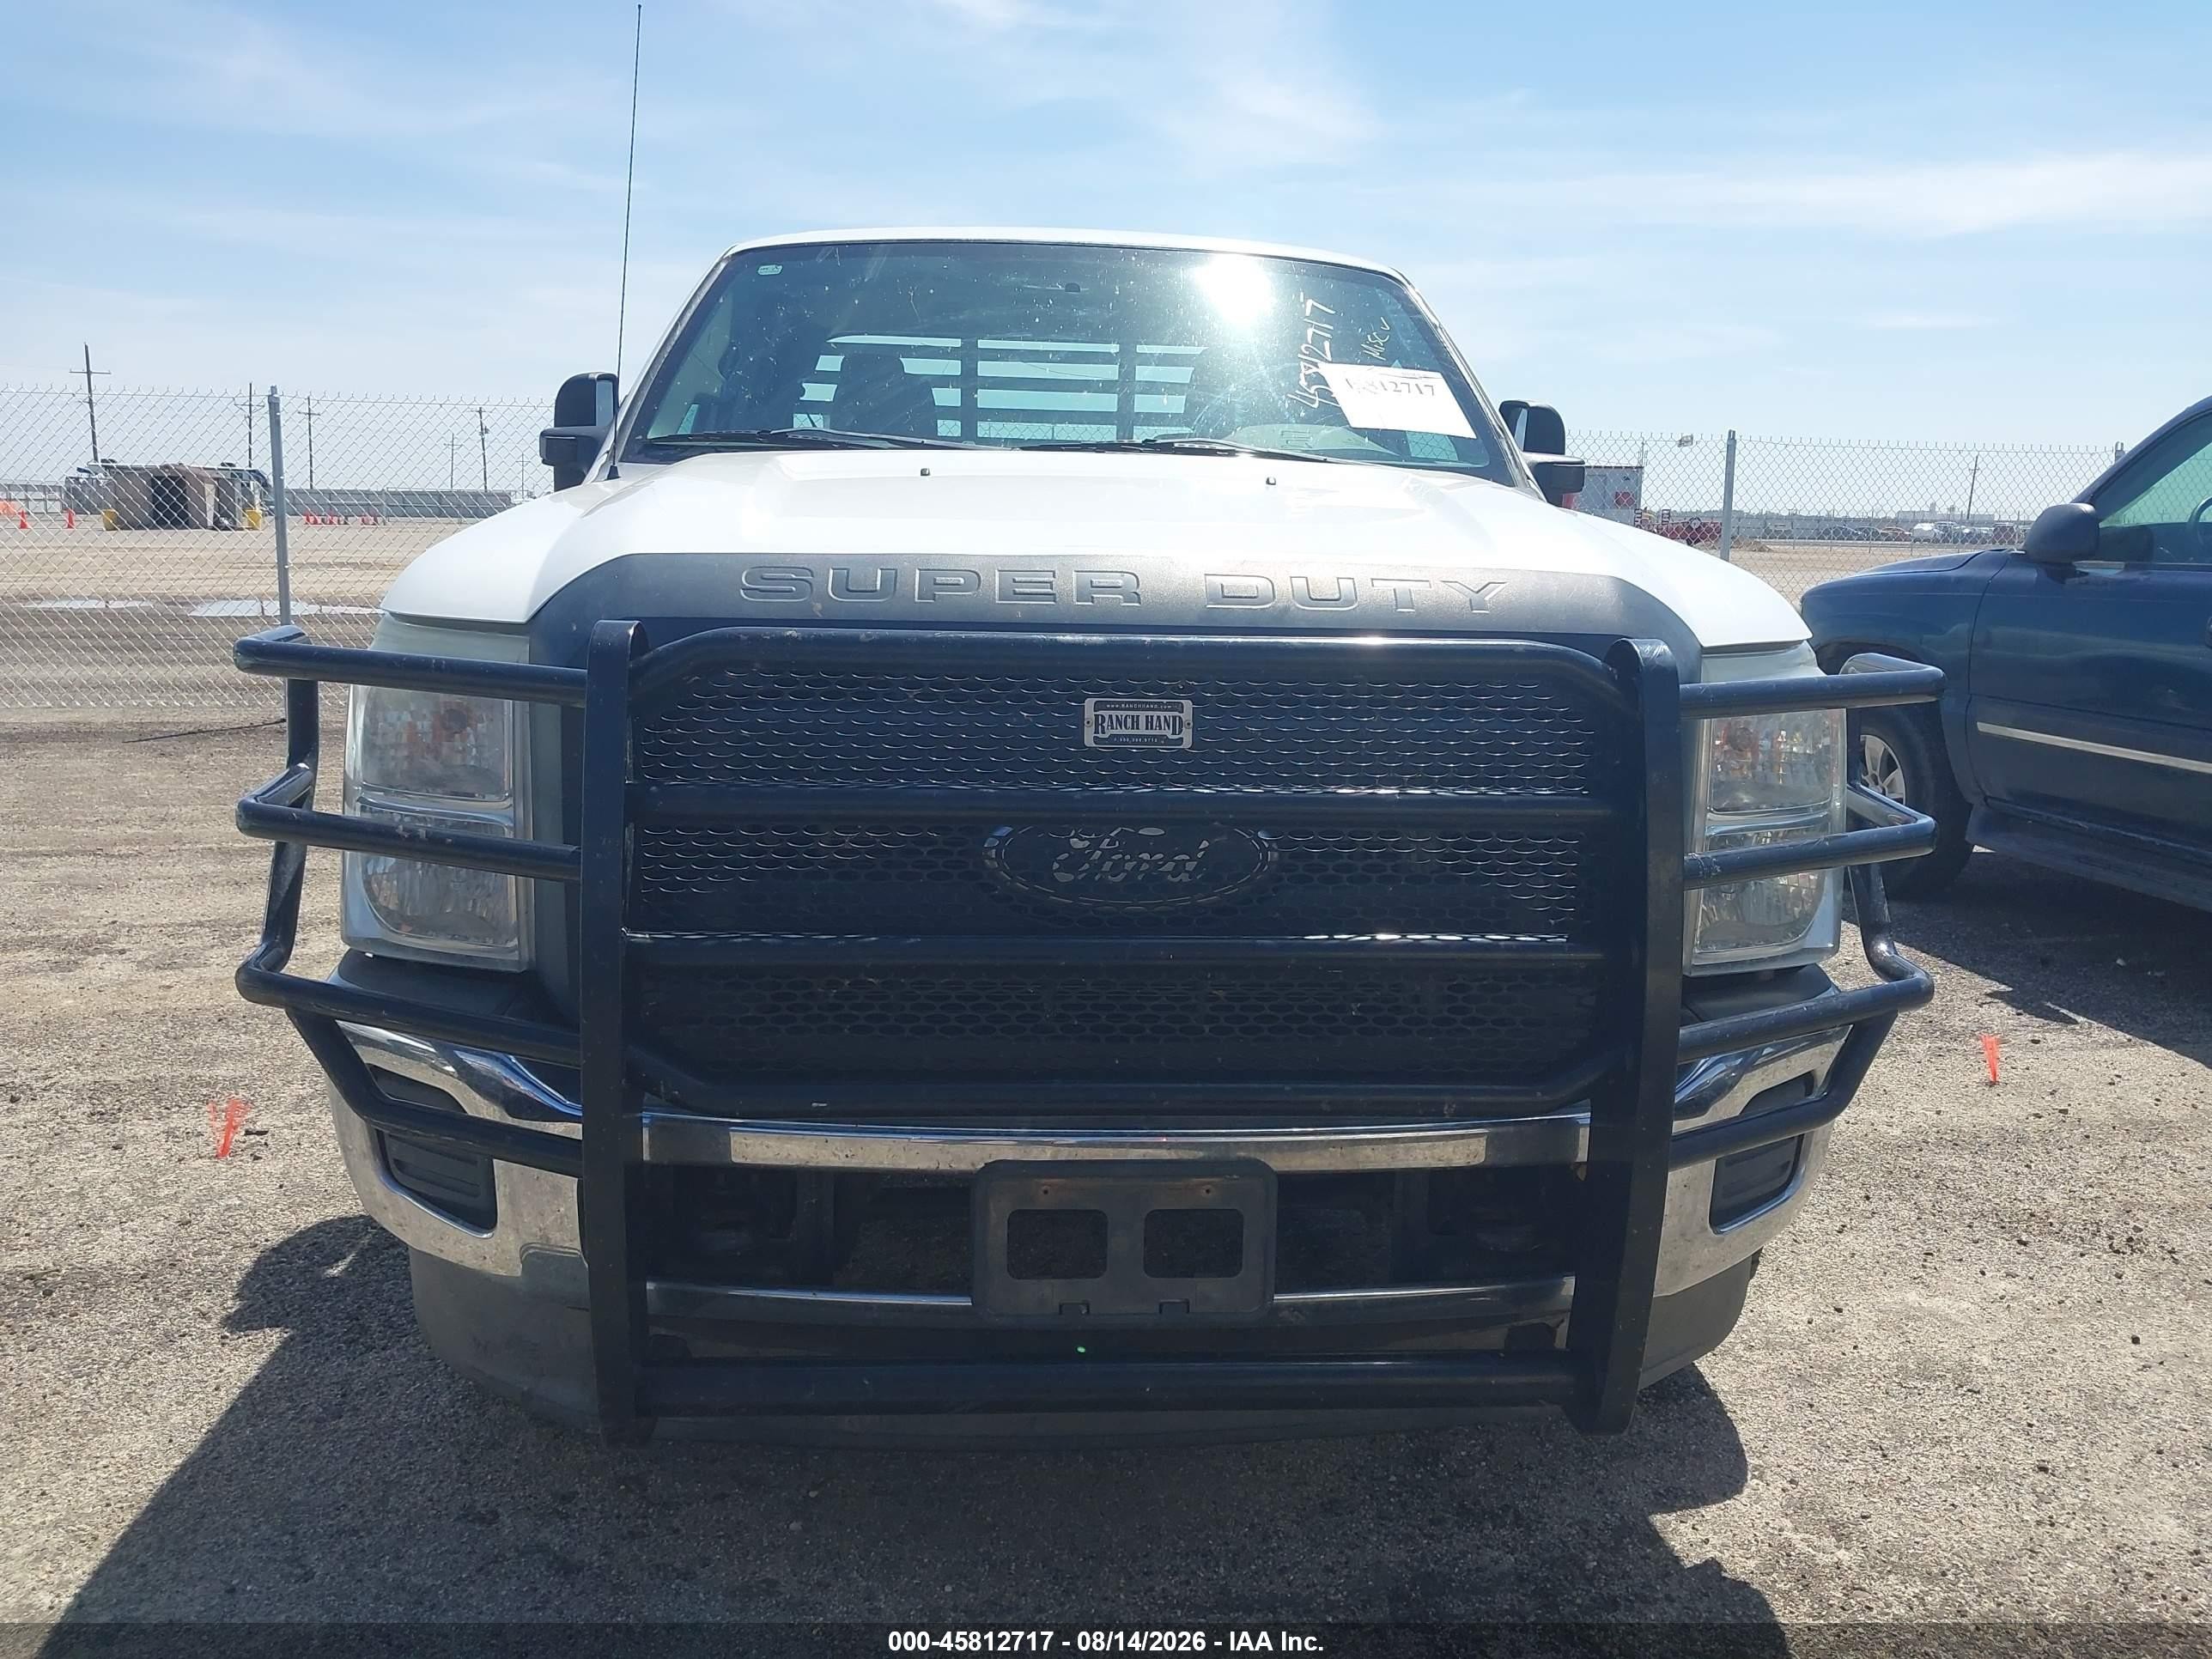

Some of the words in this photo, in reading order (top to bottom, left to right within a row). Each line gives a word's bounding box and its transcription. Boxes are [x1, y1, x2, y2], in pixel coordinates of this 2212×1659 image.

[739, 565, 1142, 606] SUPER
[1203, 573, 1510, 614] DUTY
[1093, 714, 1140, 735] RANCH
[1145, 714, 1184, 736] HAND
